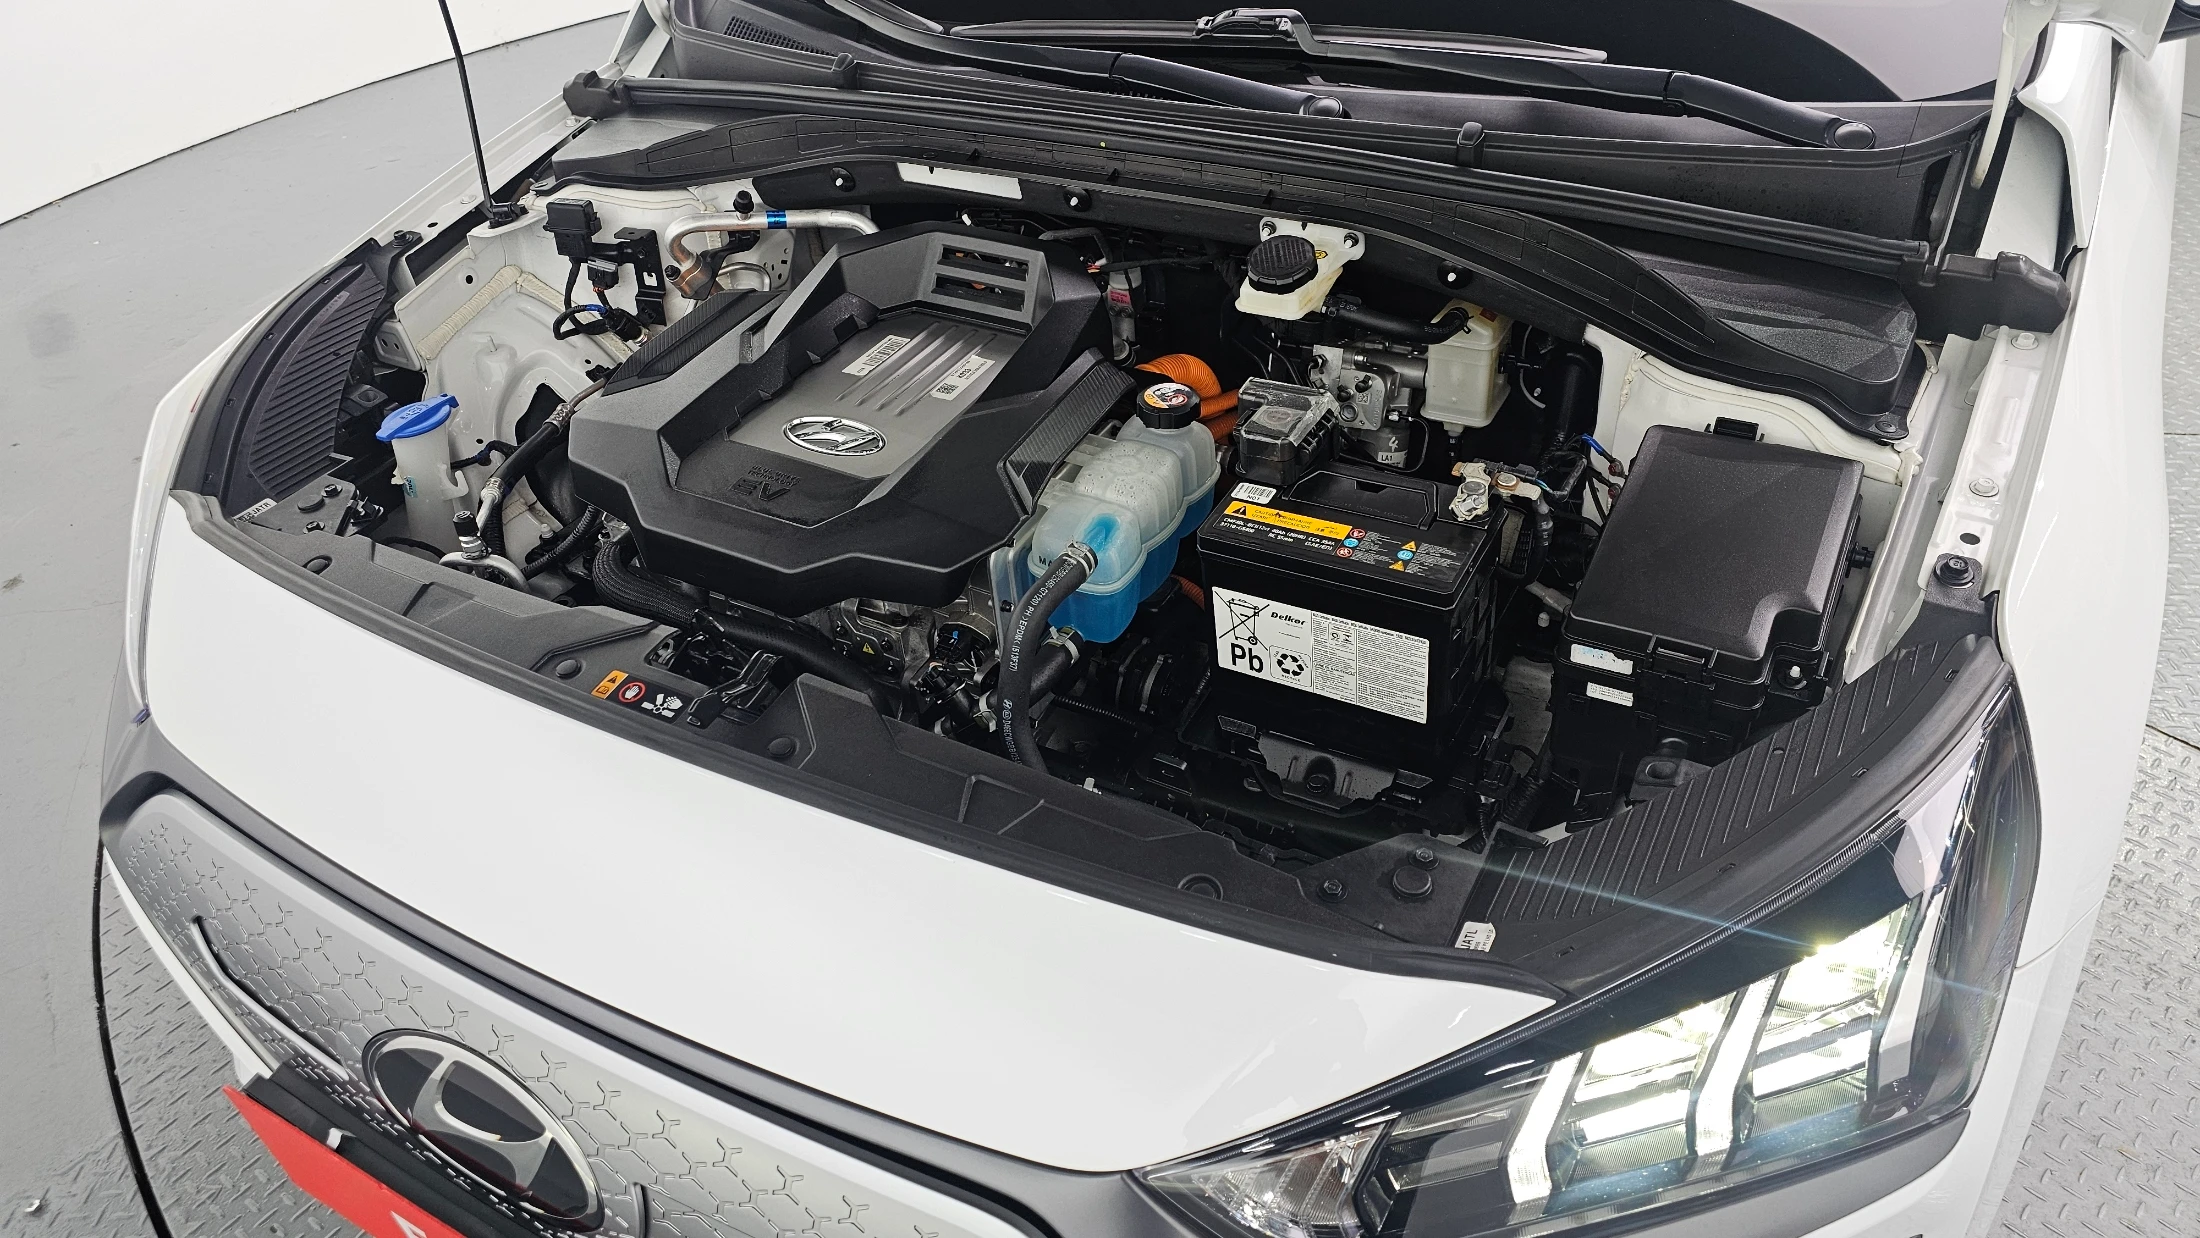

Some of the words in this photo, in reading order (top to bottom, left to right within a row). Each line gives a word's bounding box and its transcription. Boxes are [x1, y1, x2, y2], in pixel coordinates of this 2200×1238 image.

[1388, 436, 1399, 452] 4
[730, 476, 790, 501] EV
[1270, 611, 1306, 626] Delkor
[1231, 642, 1264, 673] Pb
